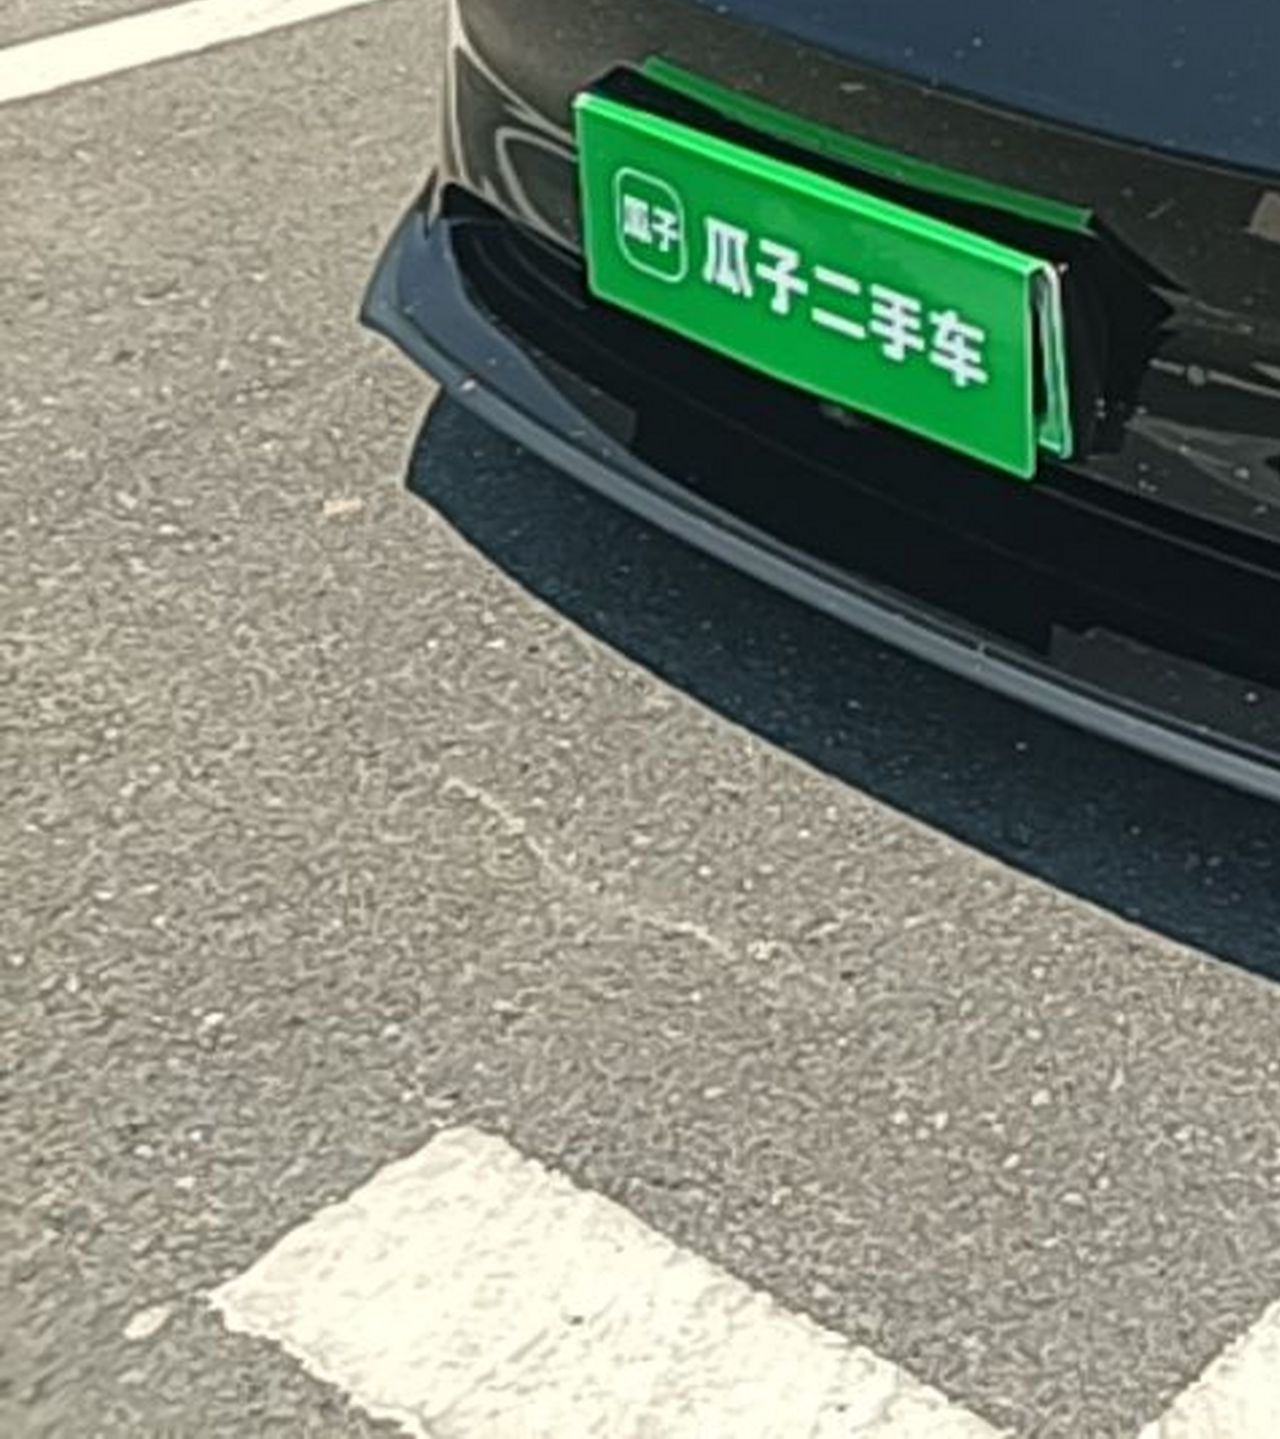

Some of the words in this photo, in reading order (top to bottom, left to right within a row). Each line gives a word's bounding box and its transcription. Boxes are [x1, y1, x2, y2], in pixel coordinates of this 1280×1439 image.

[702, 216, 989, 388] 瓜子二手车
